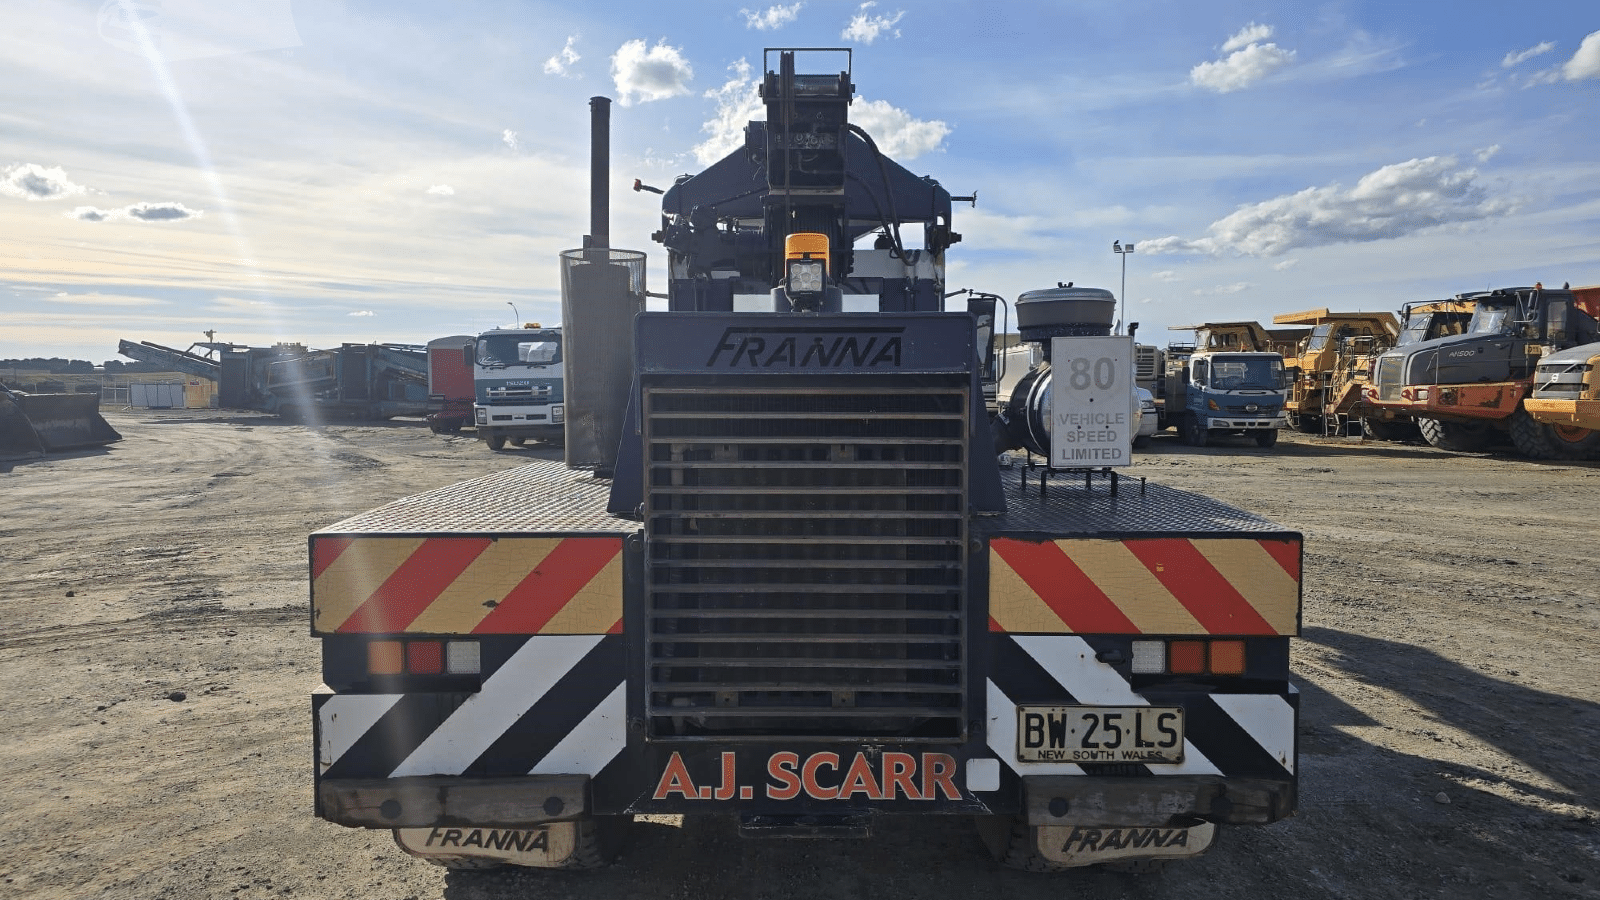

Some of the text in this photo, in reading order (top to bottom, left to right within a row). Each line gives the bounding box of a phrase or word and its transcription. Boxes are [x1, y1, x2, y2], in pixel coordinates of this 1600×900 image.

[706, 327, 906, 367] FRANNA
[1069, 357, 1116, 391] 80
[1060, 413, 1125, 425] VEHICLE
[1067, 431, 1117, 443] SPEED
[1062, 448, 1122, 460] LIMITED
[1038, 750, 1163, 760] NEW SOUTH WALES
[652, 751, 963, 801] A.J. SCARR
[425, 826, 549, 853] FRANNA
[1061, 826, 1189, 853] FRANNA
